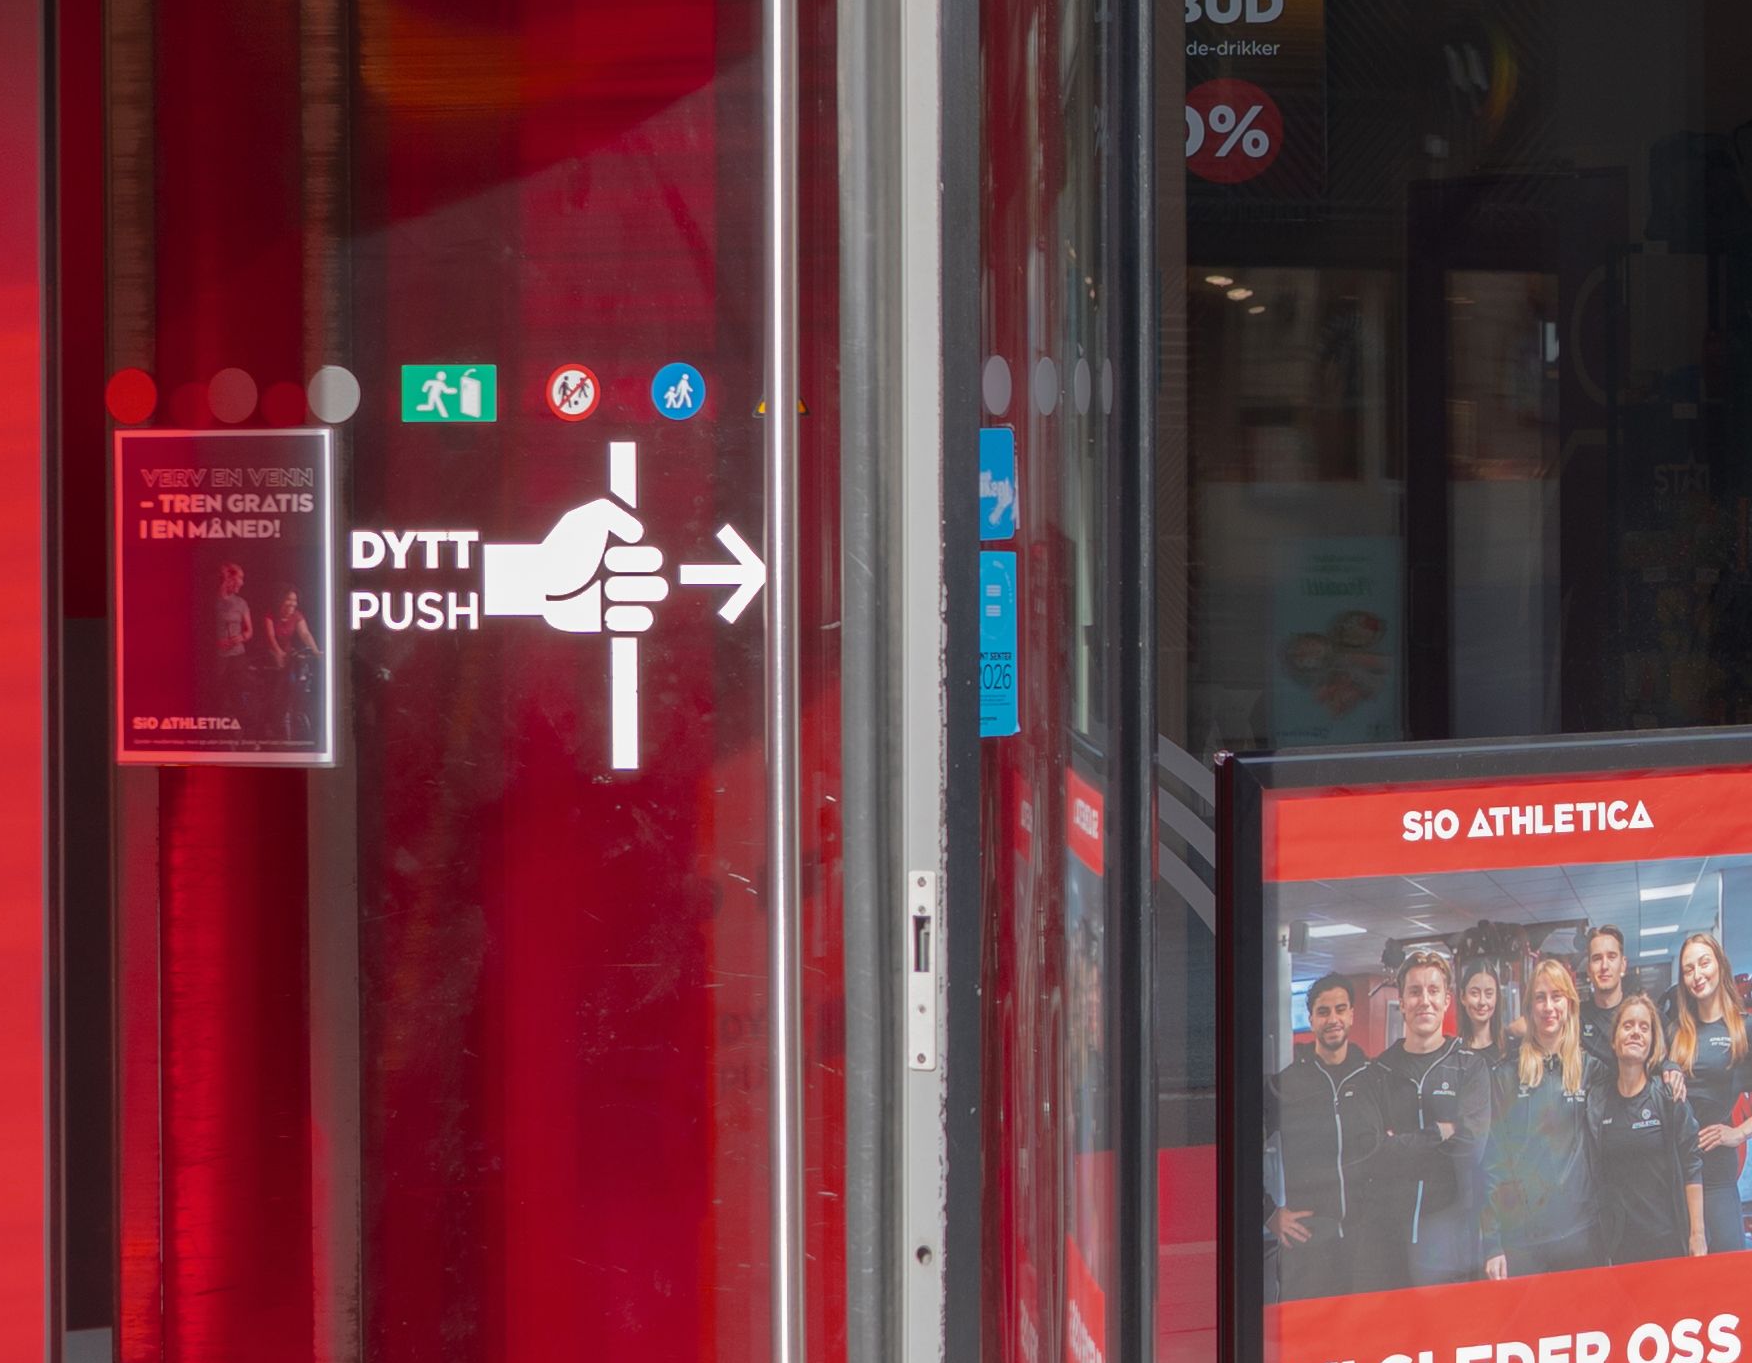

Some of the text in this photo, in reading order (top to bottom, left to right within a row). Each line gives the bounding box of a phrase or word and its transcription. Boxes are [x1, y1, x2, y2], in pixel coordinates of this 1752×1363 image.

[140, 467, 314, 488] VERV EN VENN
[158, 493, 223, 514] TREN
[226, 493, 315, 513] GRATIS
[150, 519, 184, 539] EN
[187, 516, 282, 539] MÅNED!
[351, 531, 479, 570] DYTT
[351, 591, 480, 631] PUSH
[132, 716, 242, 731] SiO ATHLETICA
[1402, 800, 1655, 842] SiO ATHLETICA
